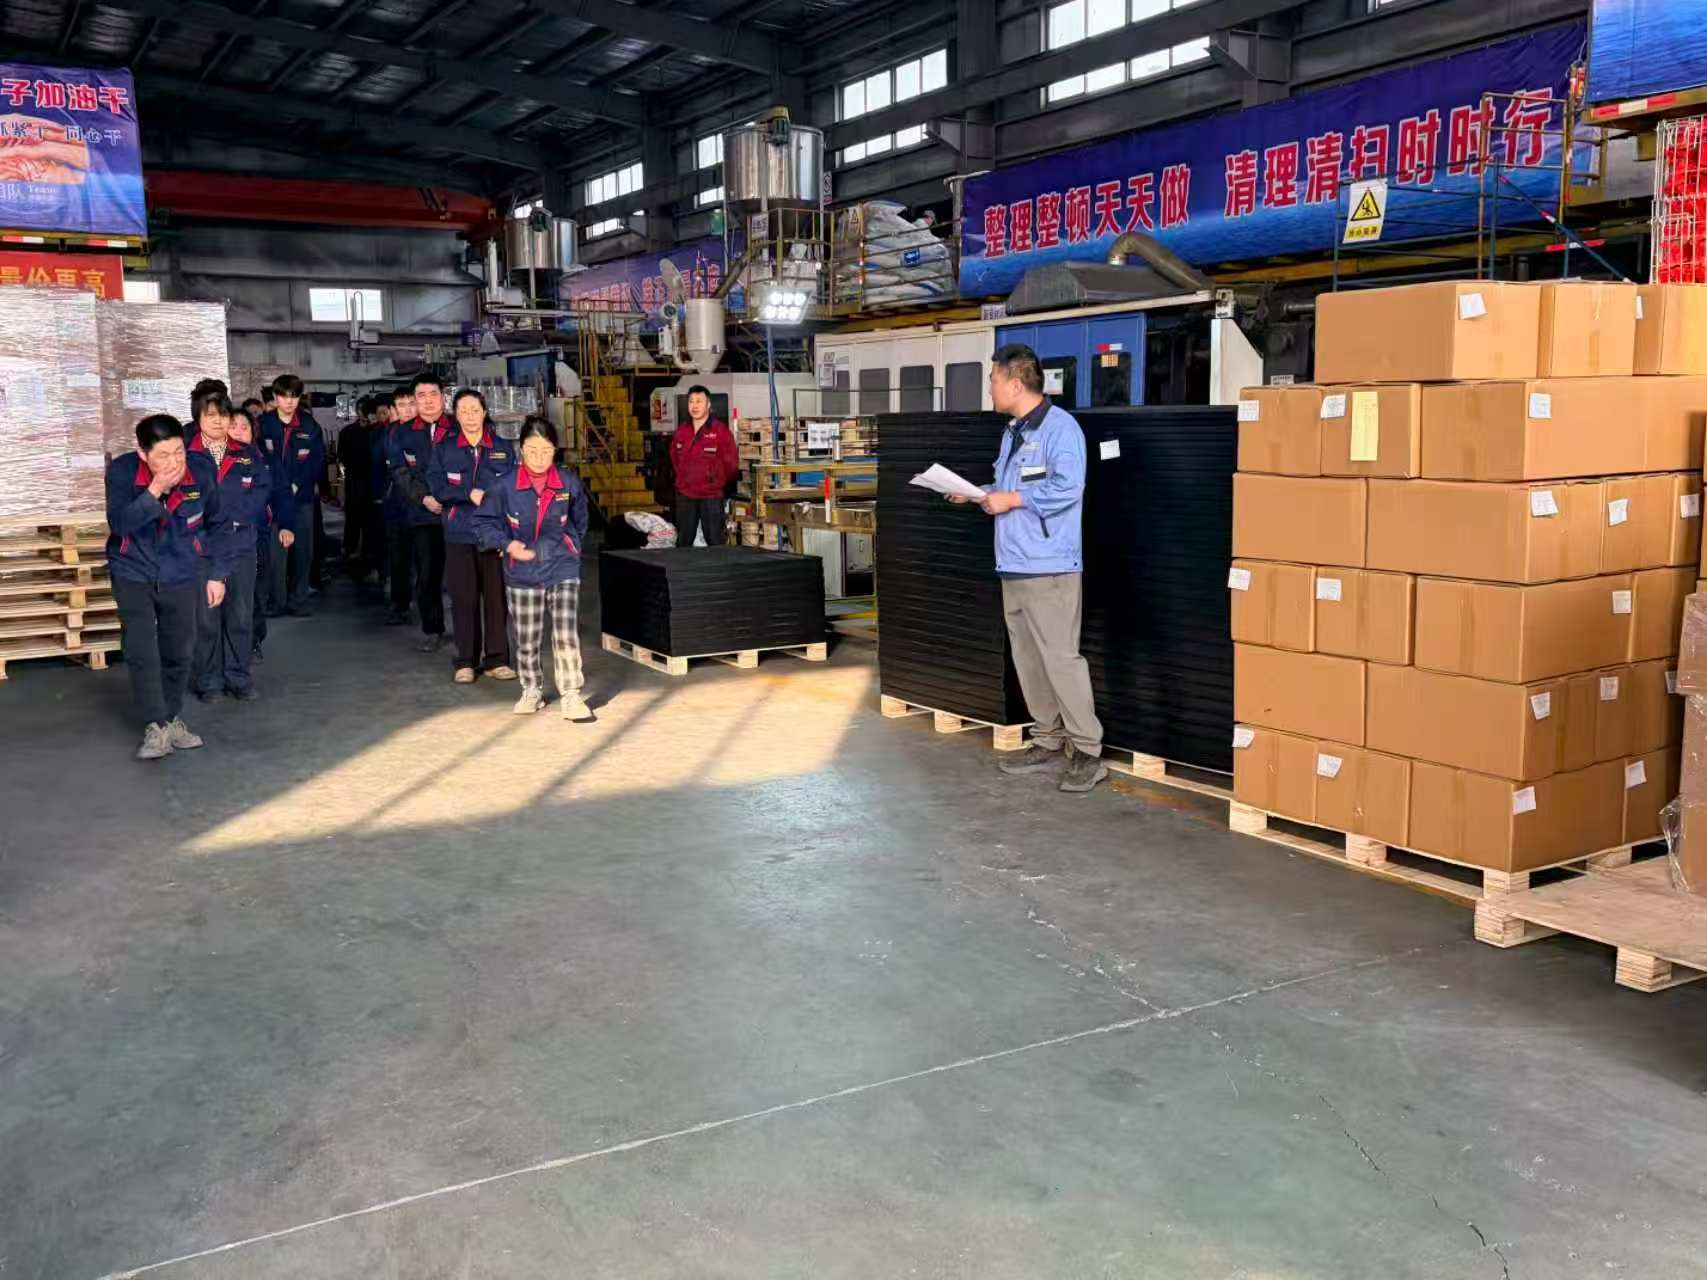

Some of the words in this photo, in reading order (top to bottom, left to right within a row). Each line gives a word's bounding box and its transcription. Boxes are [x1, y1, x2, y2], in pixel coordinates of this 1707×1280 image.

[984, 163, 1191, 259] 整理整顿天天做
[1224, 87, 1553, 218] 清理清扫时时行
